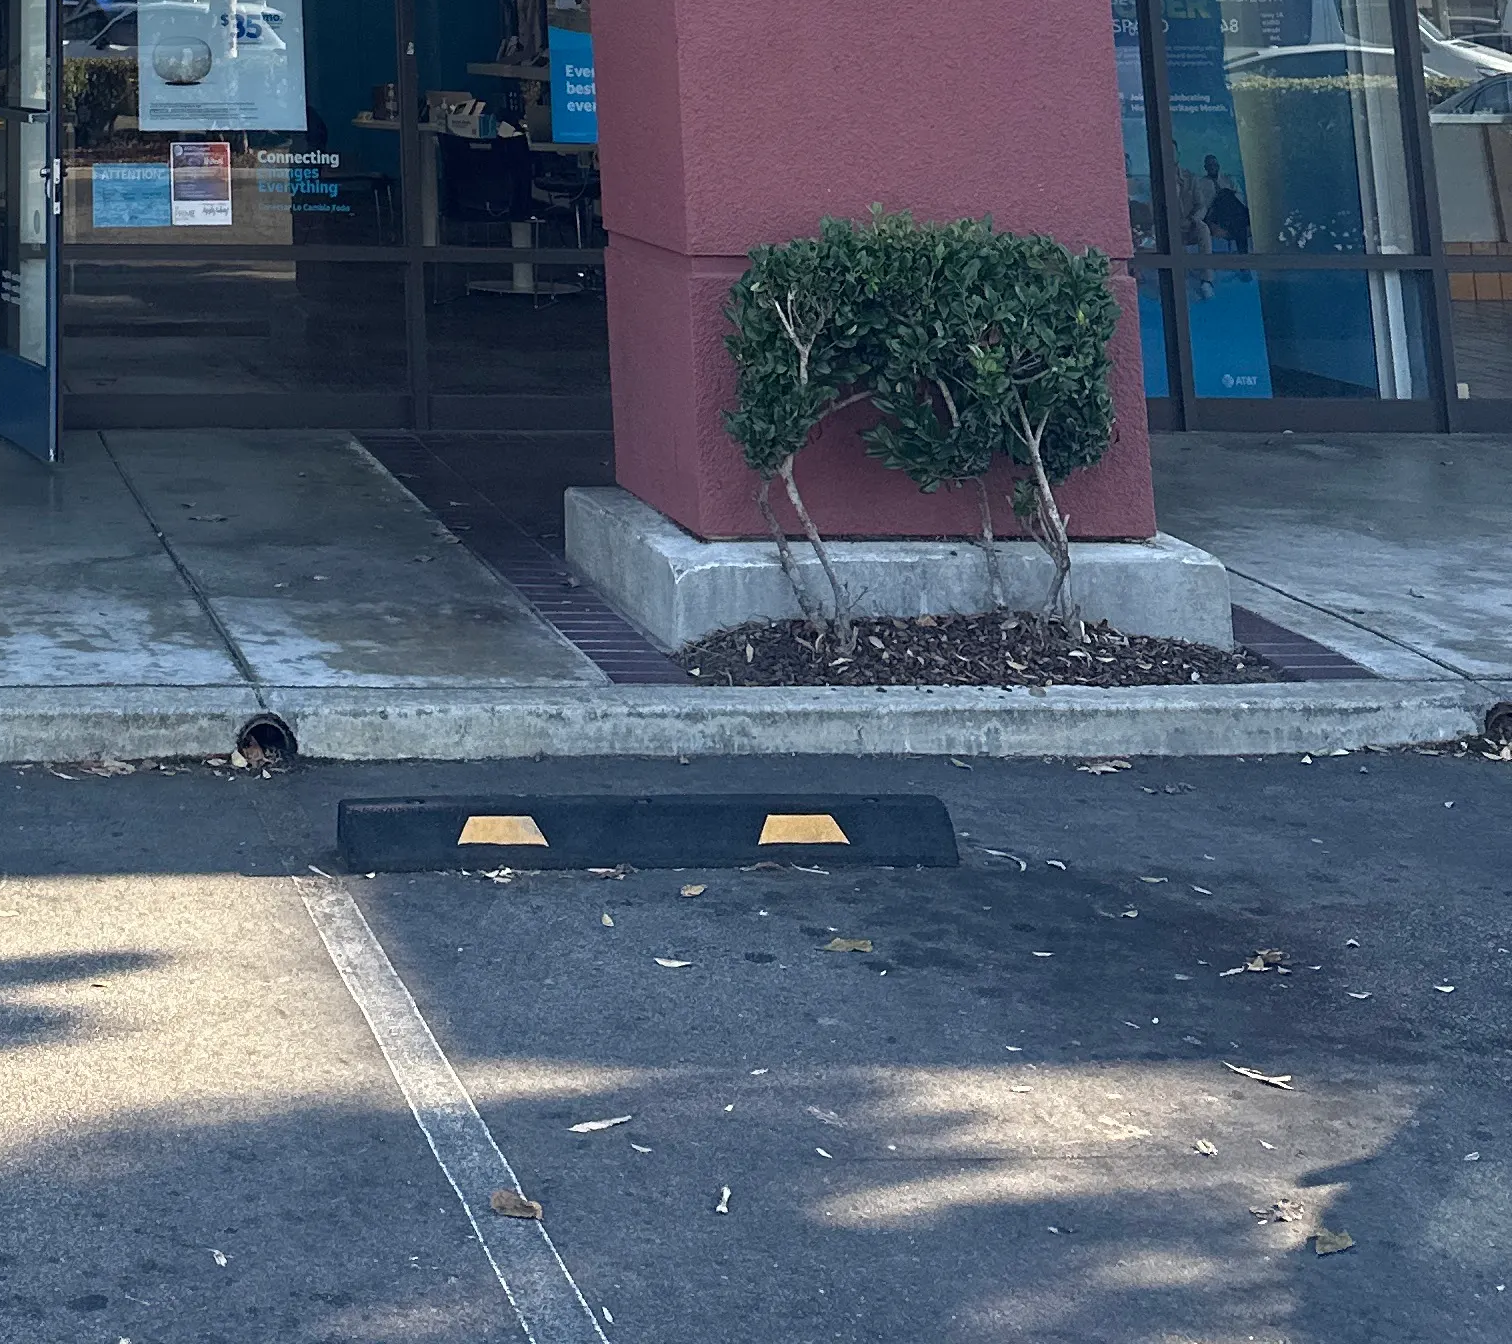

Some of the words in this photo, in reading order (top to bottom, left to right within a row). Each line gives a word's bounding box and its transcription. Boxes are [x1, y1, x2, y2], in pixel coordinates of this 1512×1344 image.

[257, 150, 340, 168] Connecting
[258, 179, 339, 198] Everything
[1235, 375, 1258, 386] AT&T
